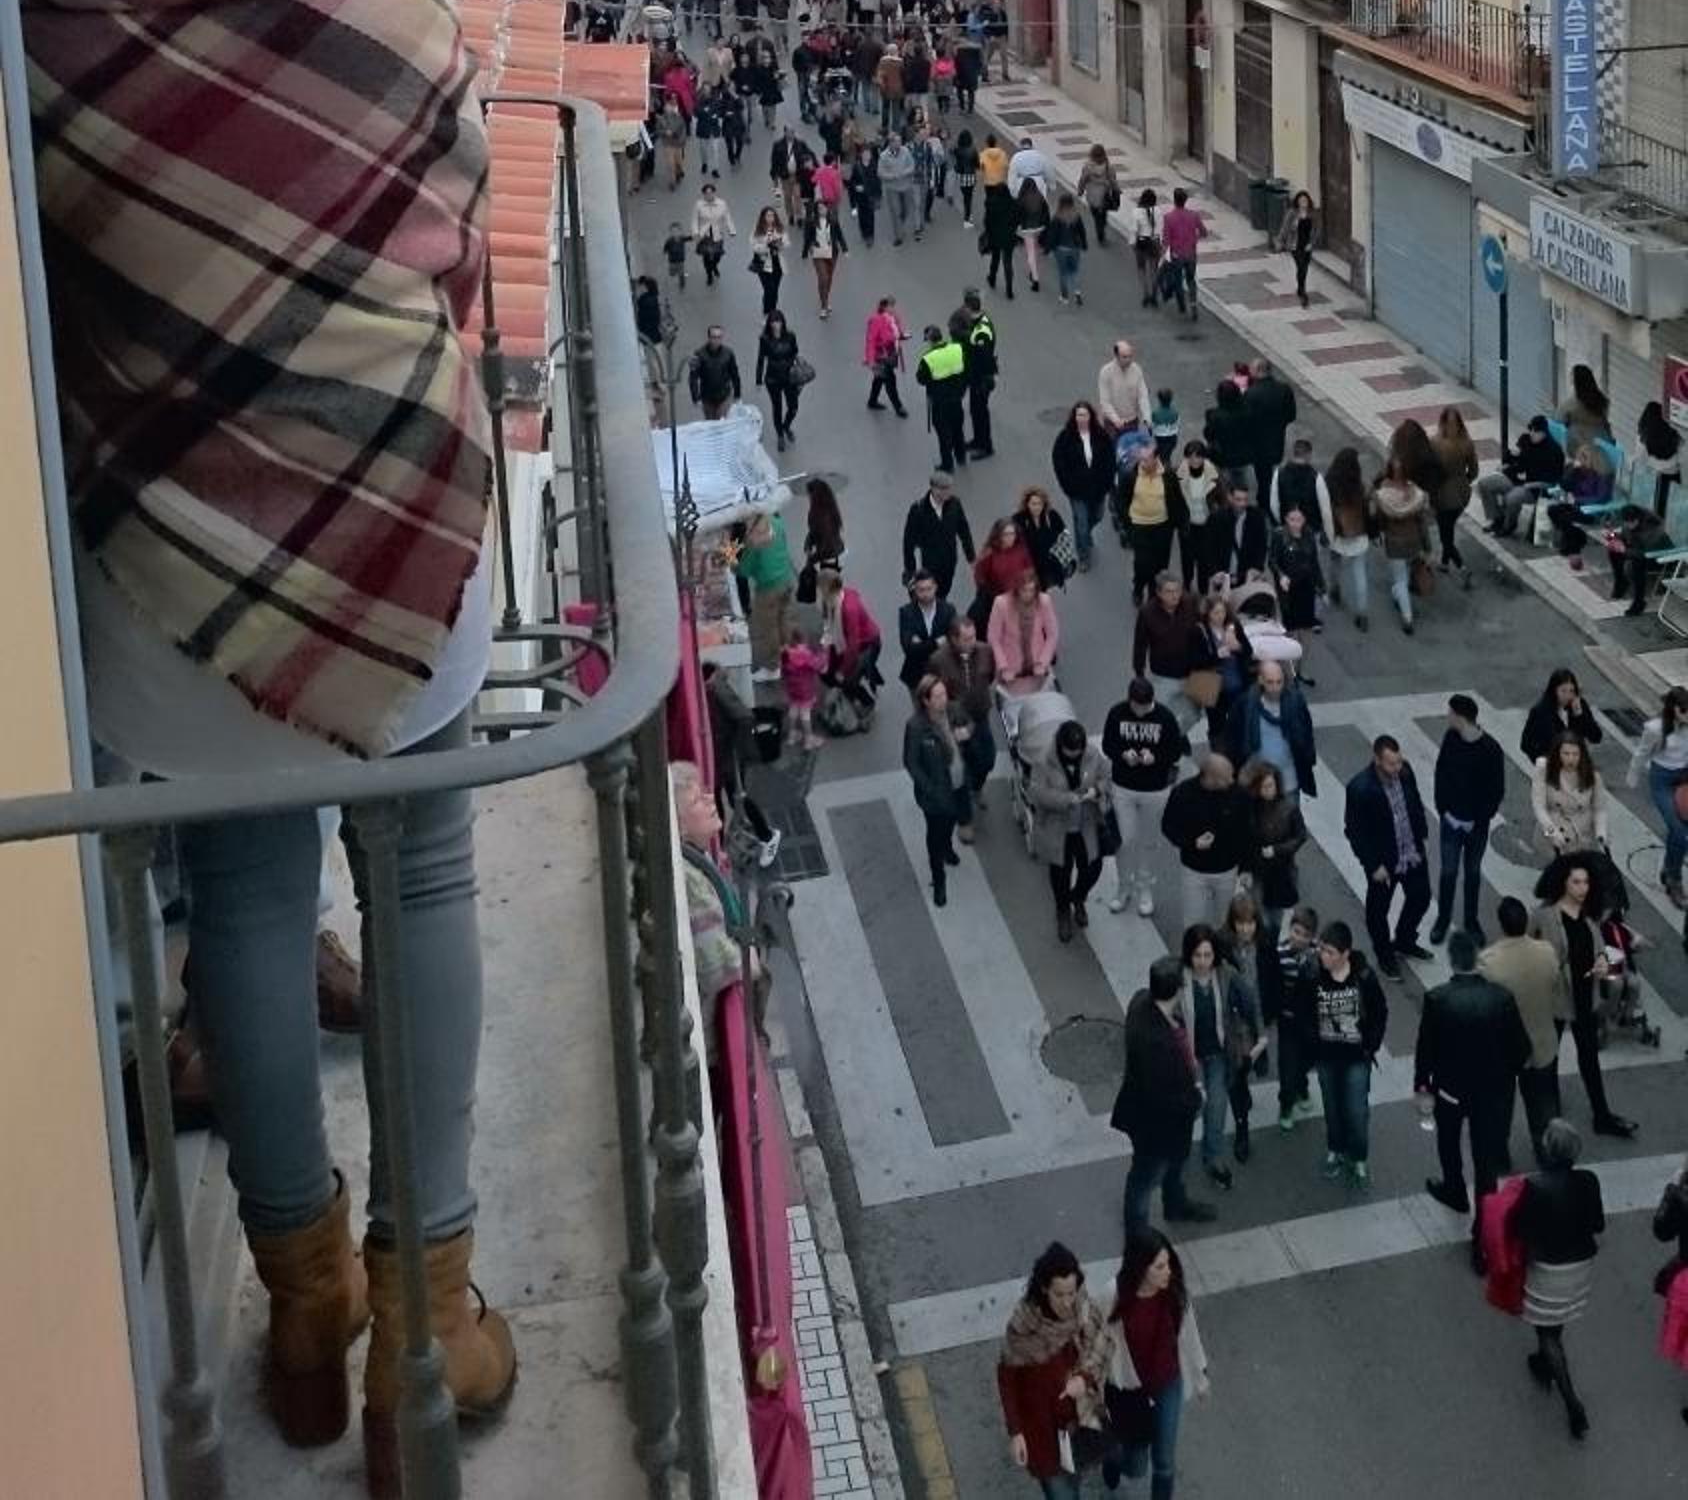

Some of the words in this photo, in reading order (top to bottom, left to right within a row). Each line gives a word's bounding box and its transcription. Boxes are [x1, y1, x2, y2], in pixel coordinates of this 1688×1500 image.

[1529, 233, 1546, 264] LA
[1547, 241, 1629, 309] CASTELLANA
[1543, 211, 1614, 267] CALZADOS
